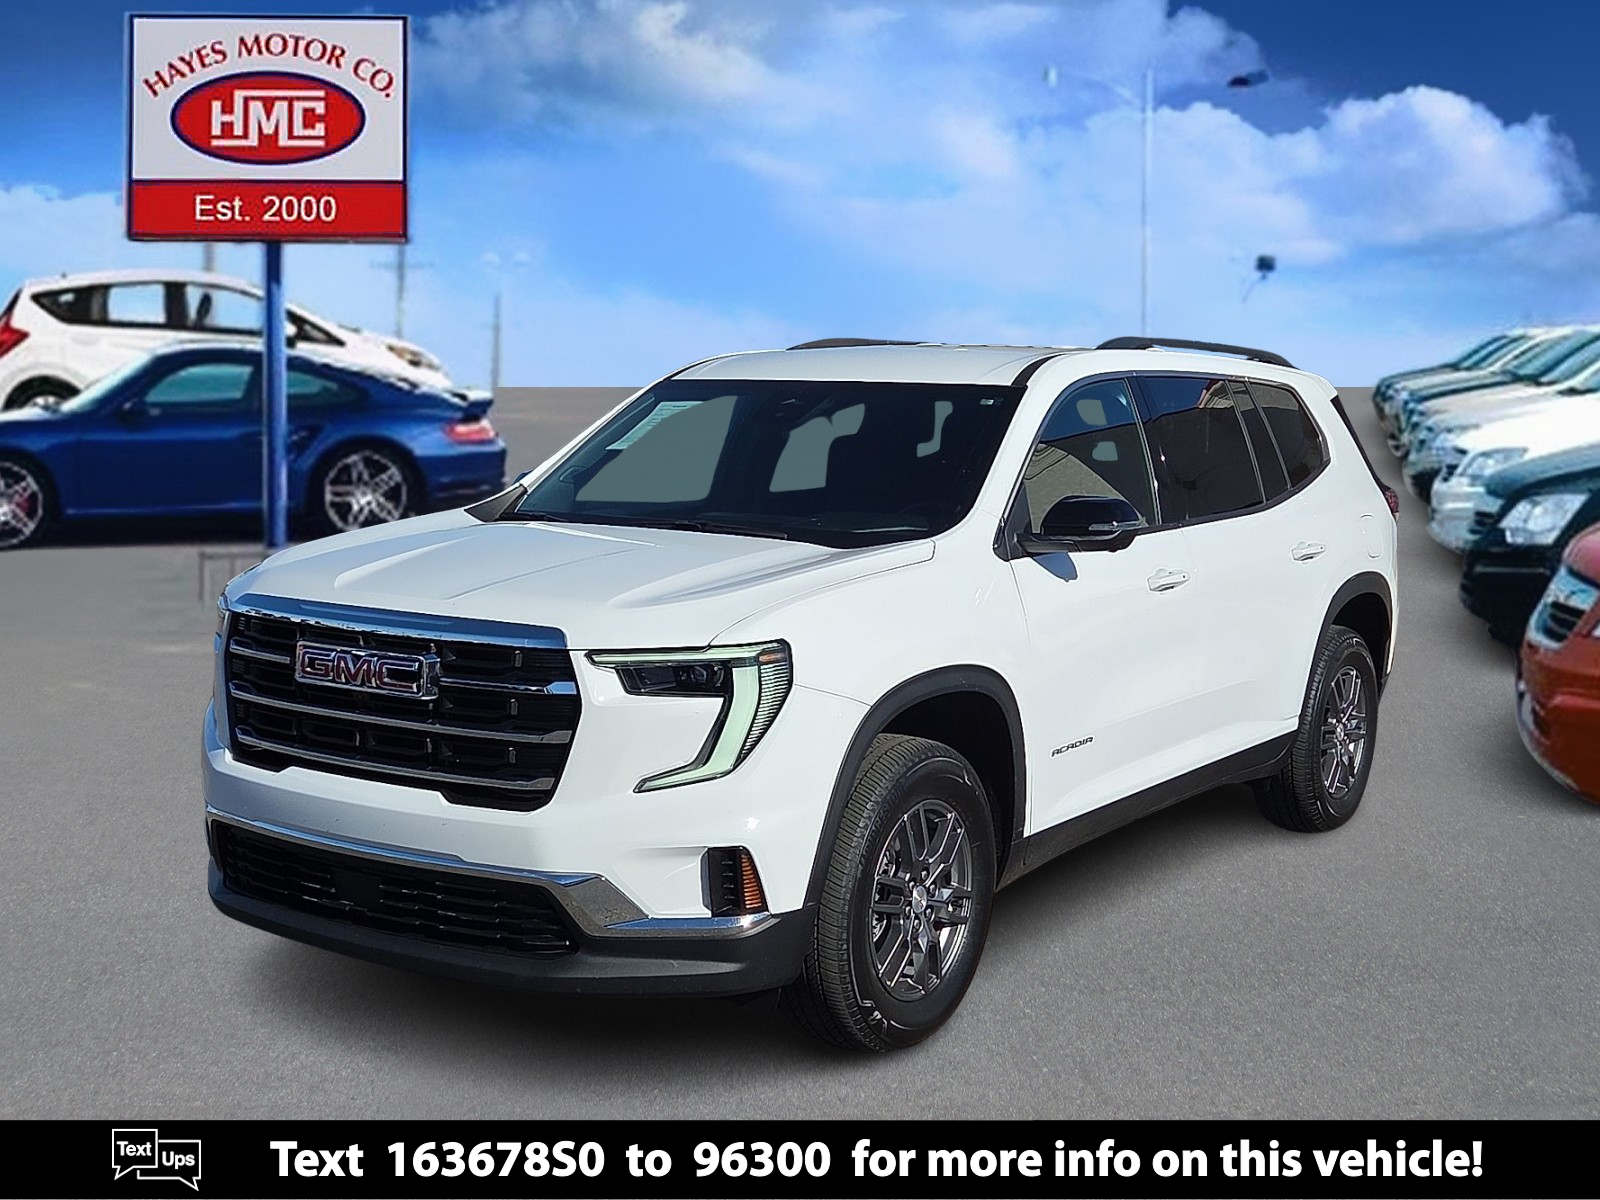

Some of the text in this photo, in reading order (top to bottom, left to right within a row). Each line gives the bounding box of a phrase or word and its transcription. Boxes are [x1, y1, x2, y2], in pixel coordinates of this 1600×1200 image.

[142, 32, 394, 99] HAYES MOTOR CO.
[210, 88, 326, 147] HMC
[194, 194, 337, 222] Est. 2000
[300, 649, 420, 693] GMC
[1051, 736, 1094, 757] ACADIA
